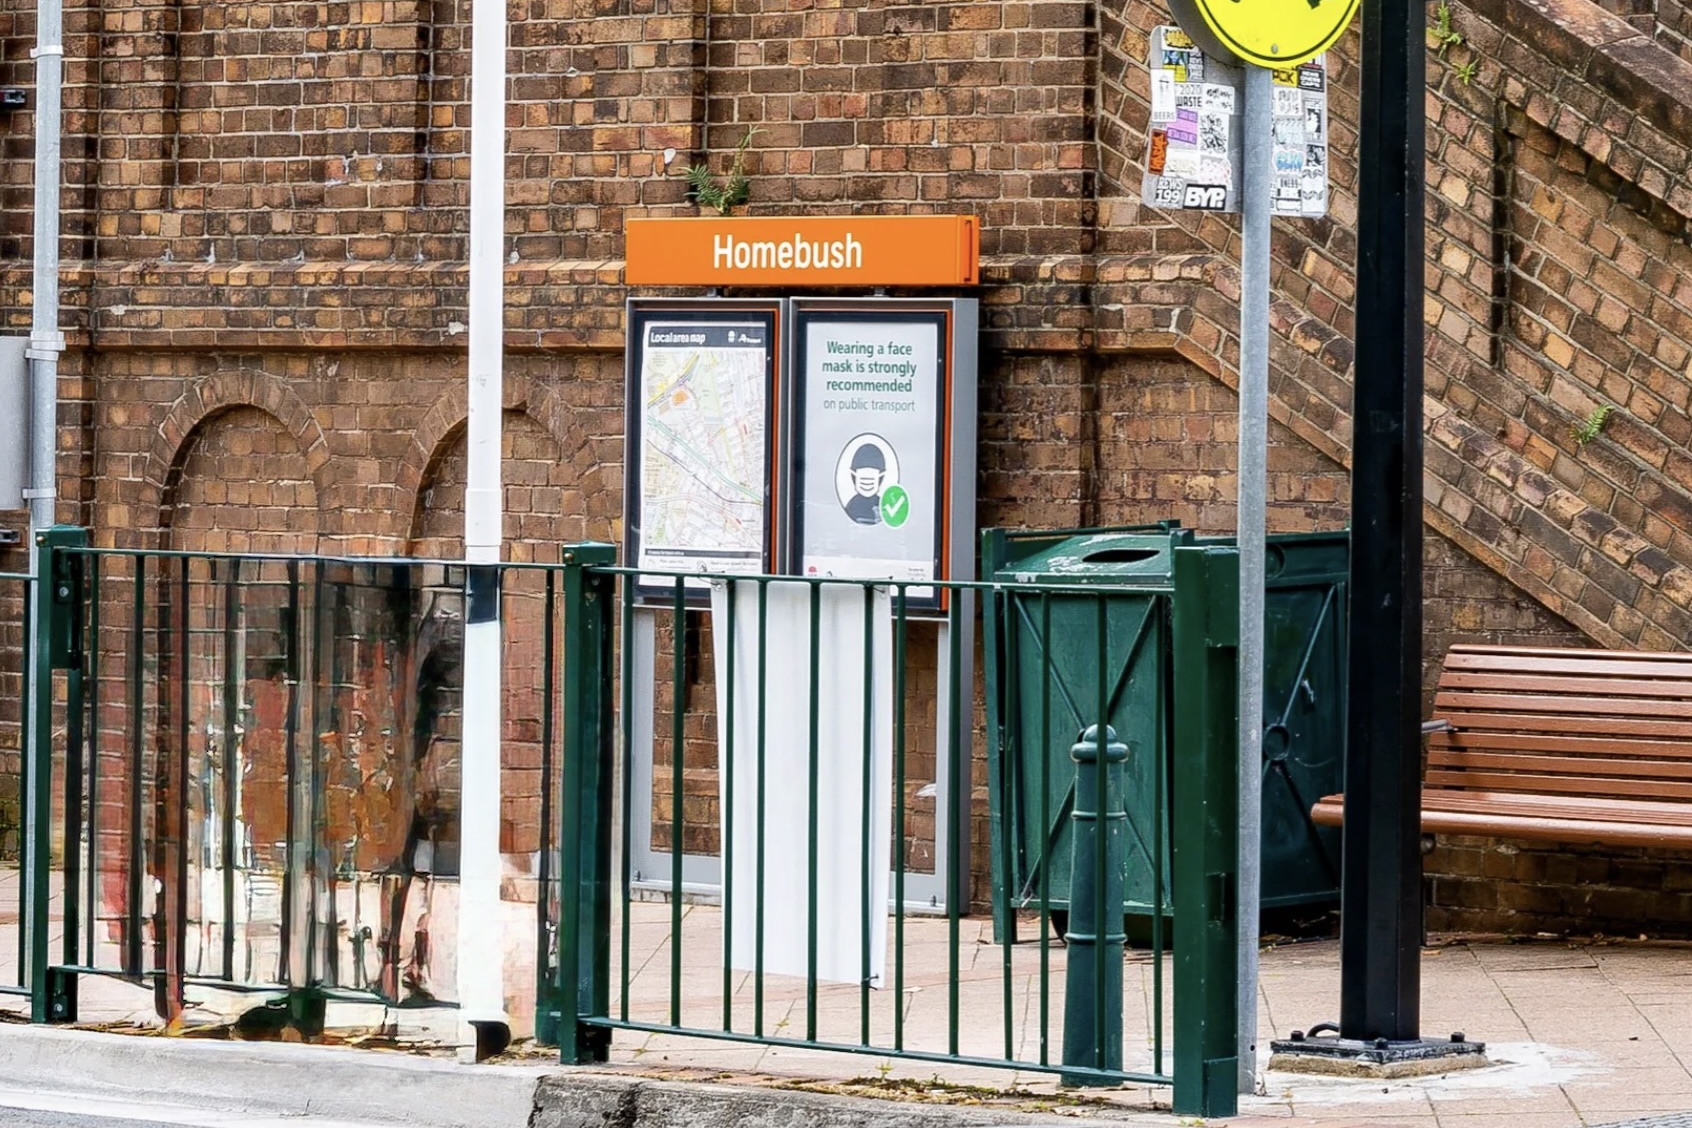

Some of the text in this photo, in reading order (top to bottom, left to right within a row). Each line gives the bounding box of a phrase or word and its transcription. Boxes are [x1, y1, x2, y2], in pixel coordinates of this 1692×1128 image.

[713, 232, 863, 269] Homebush
[650, 332, 706, 345] Local area map
[826, 340, 912, 358] Wearing a face
[822, 359, 917, 377] mask is strongly
[826, 378, 912, 392] recommended
[823, 397, 915, 414] on public transport
